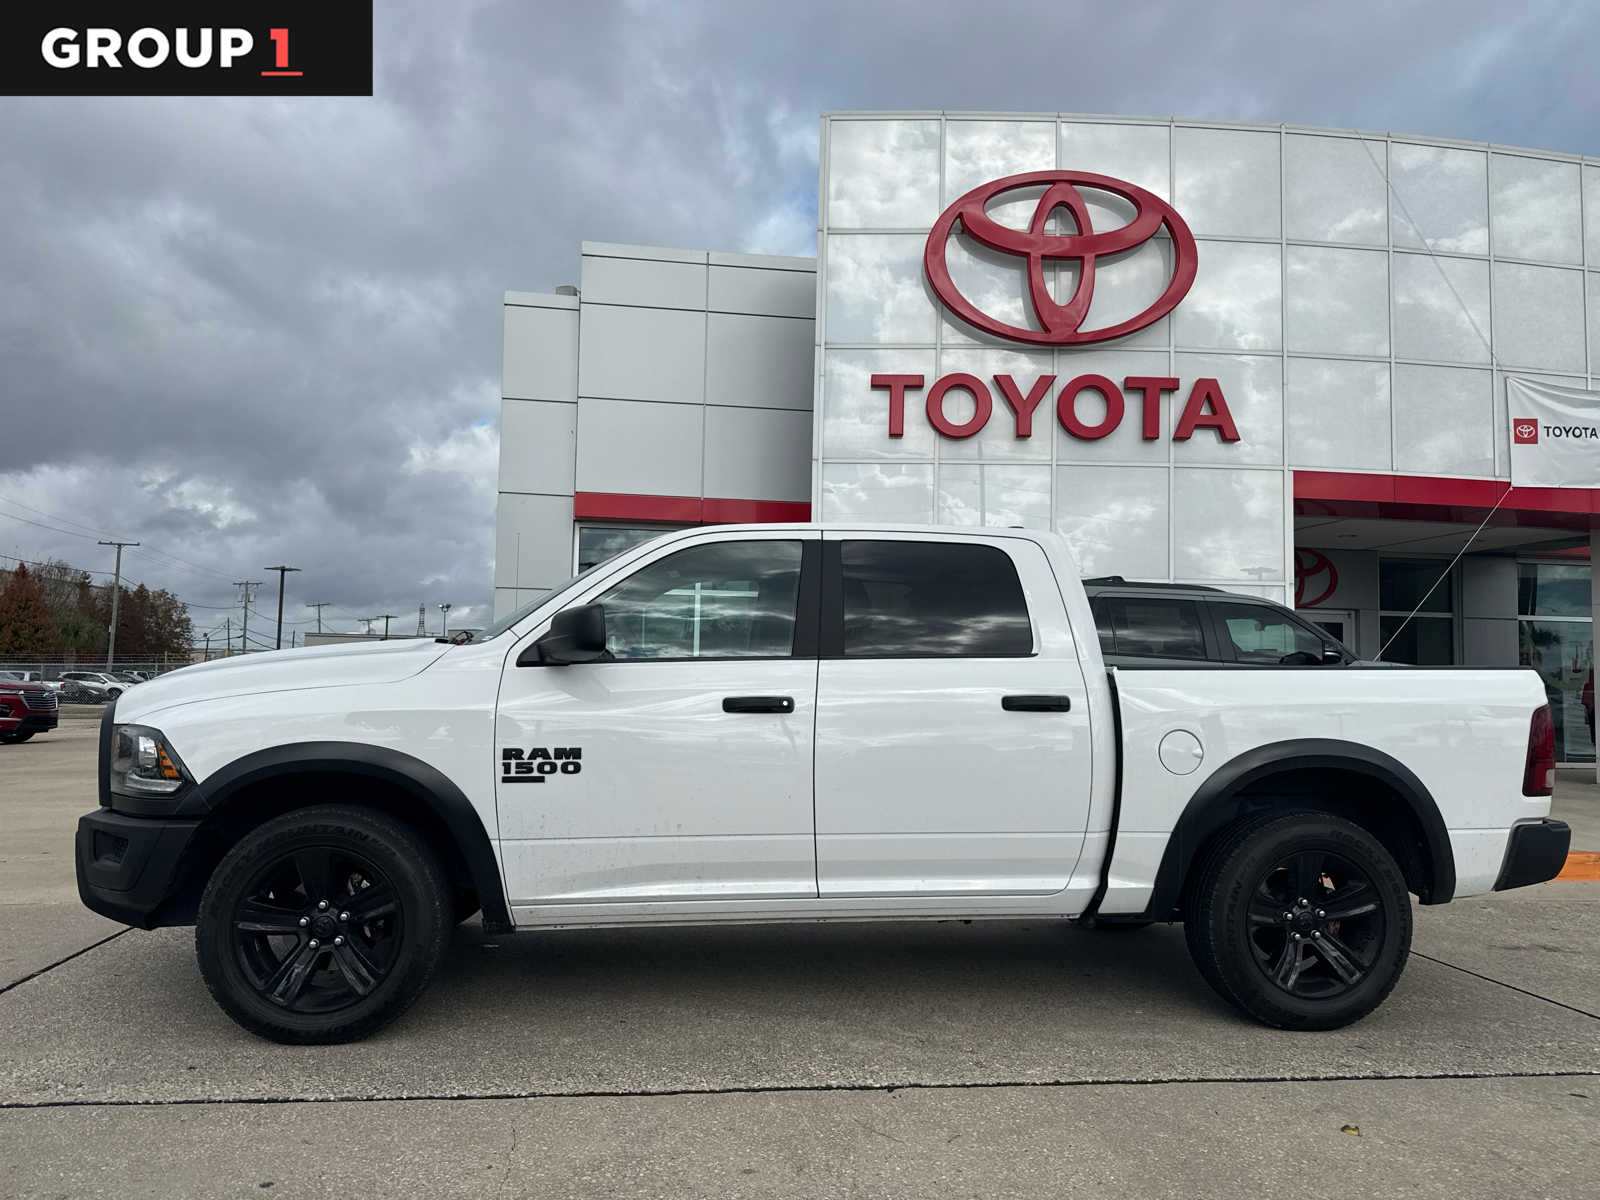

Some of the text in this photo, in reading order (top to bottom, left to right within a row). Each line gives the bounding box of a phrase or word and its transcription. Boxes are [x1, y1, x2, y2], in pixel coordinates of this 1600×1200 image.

[870, 373, 1241, 443] TOYOTA
[1543, 426, 1599, 439] TOYOTA
[502, 747, 582, 760] RAM
[502, 761, 582, 775] 1500
